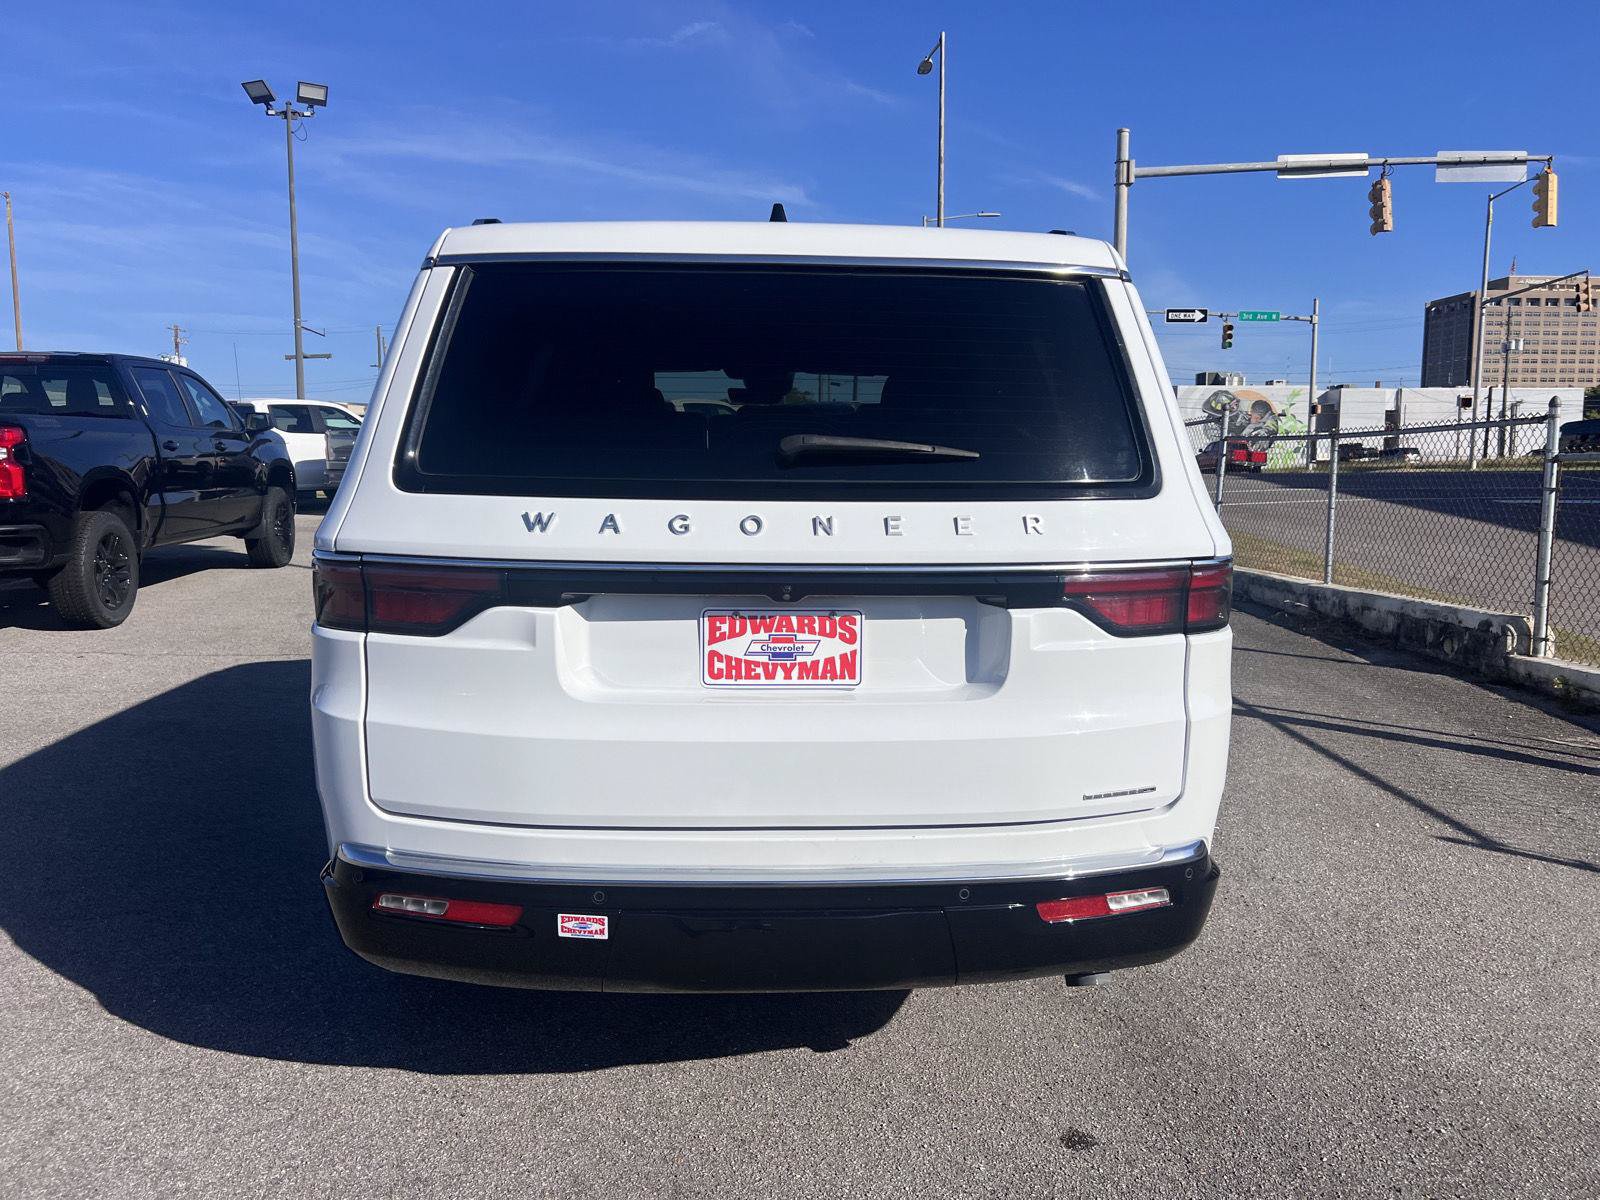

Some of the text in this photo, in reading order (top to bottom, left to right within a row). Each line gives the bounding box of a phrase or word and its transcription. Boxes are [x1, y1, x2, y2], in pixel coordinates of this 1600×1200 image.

[1242, 312, 1253, 320] 3rd
[521, 511, 1043, 537] WAGONEER
[707, 615, 858, 646] EDWARDS
[760, 643, 805, 652] Chevrolet
[707, 649, 858, 681] CHEVYMAN
[560, 915, 606, 926] EDWARDS
[560, 925, 606, 936] CHEVYMAN
